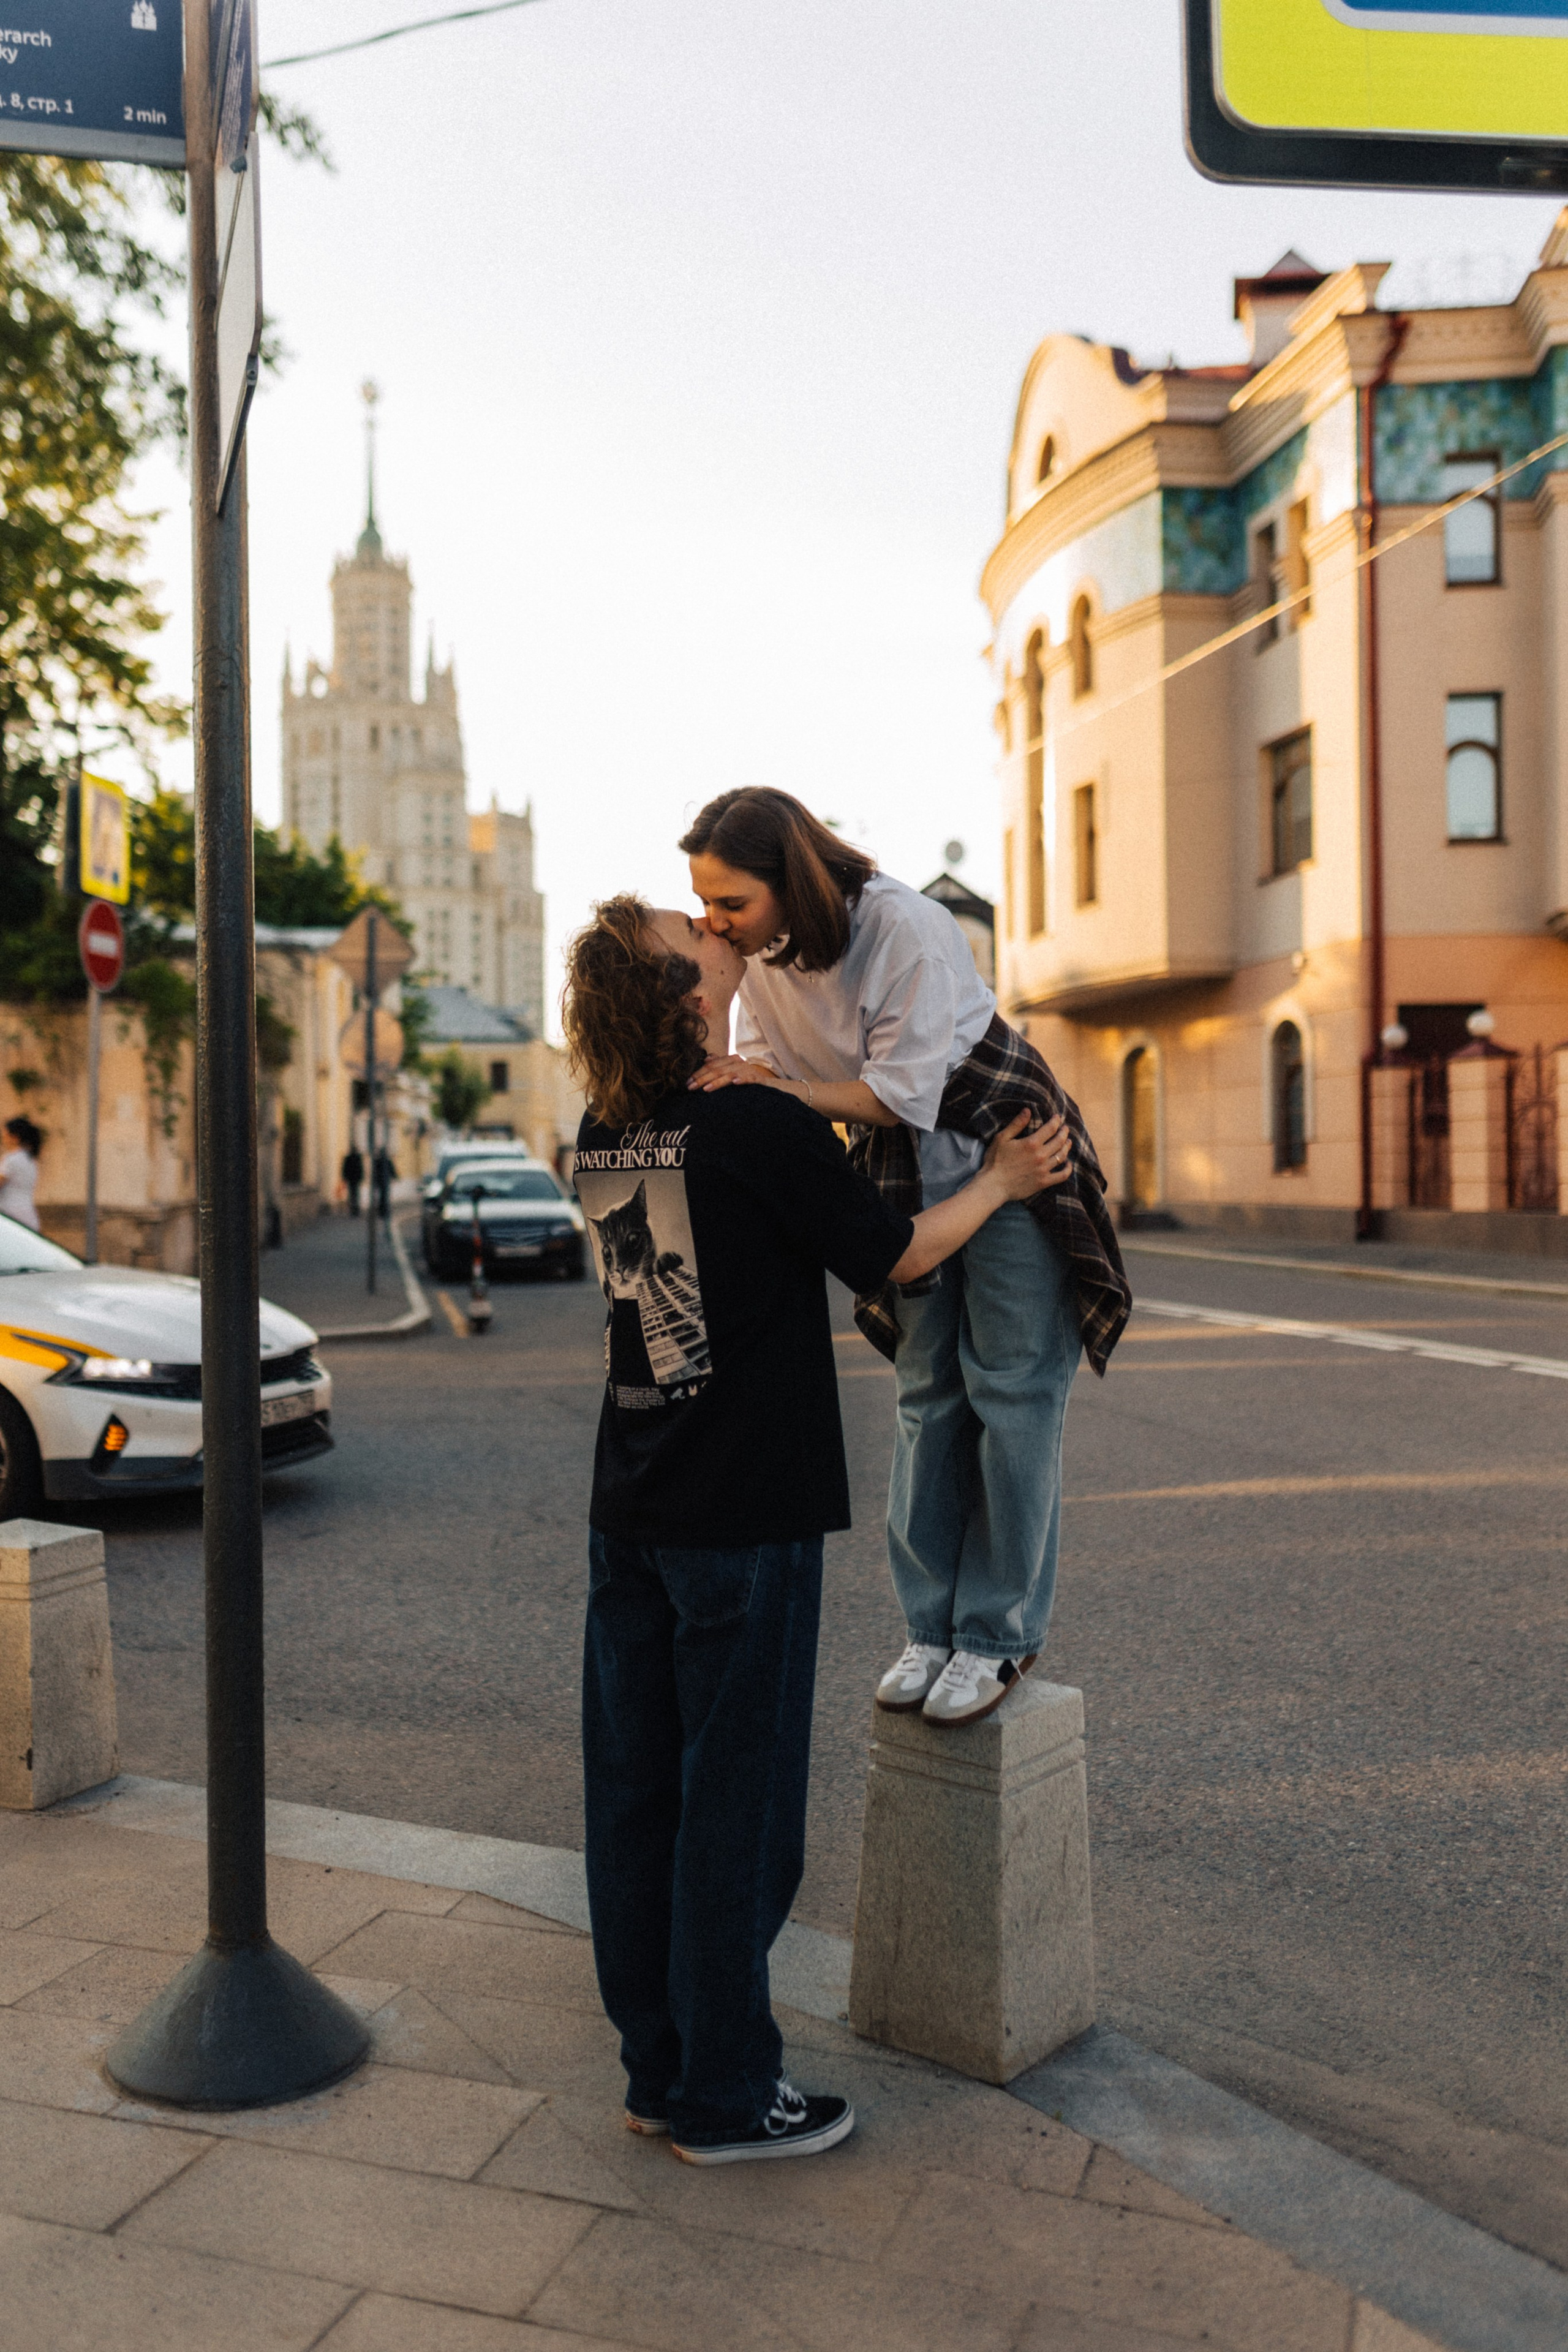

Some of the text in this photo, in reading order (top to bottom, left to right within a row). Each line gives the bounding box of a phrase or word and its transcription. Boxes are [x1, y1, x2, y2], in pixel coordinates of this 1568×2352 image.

[10, 92, 24, 111] 8,
[27, 97, 61, 115] стр.
[65, 99, 74, 114] 1
[124, 105, 167, 125] 2 min
[620, 1119, 691, 1151] The cat
[579, 1149, 652, 1169] WATCHING
[654, 1148, 686, 1167] YOU
